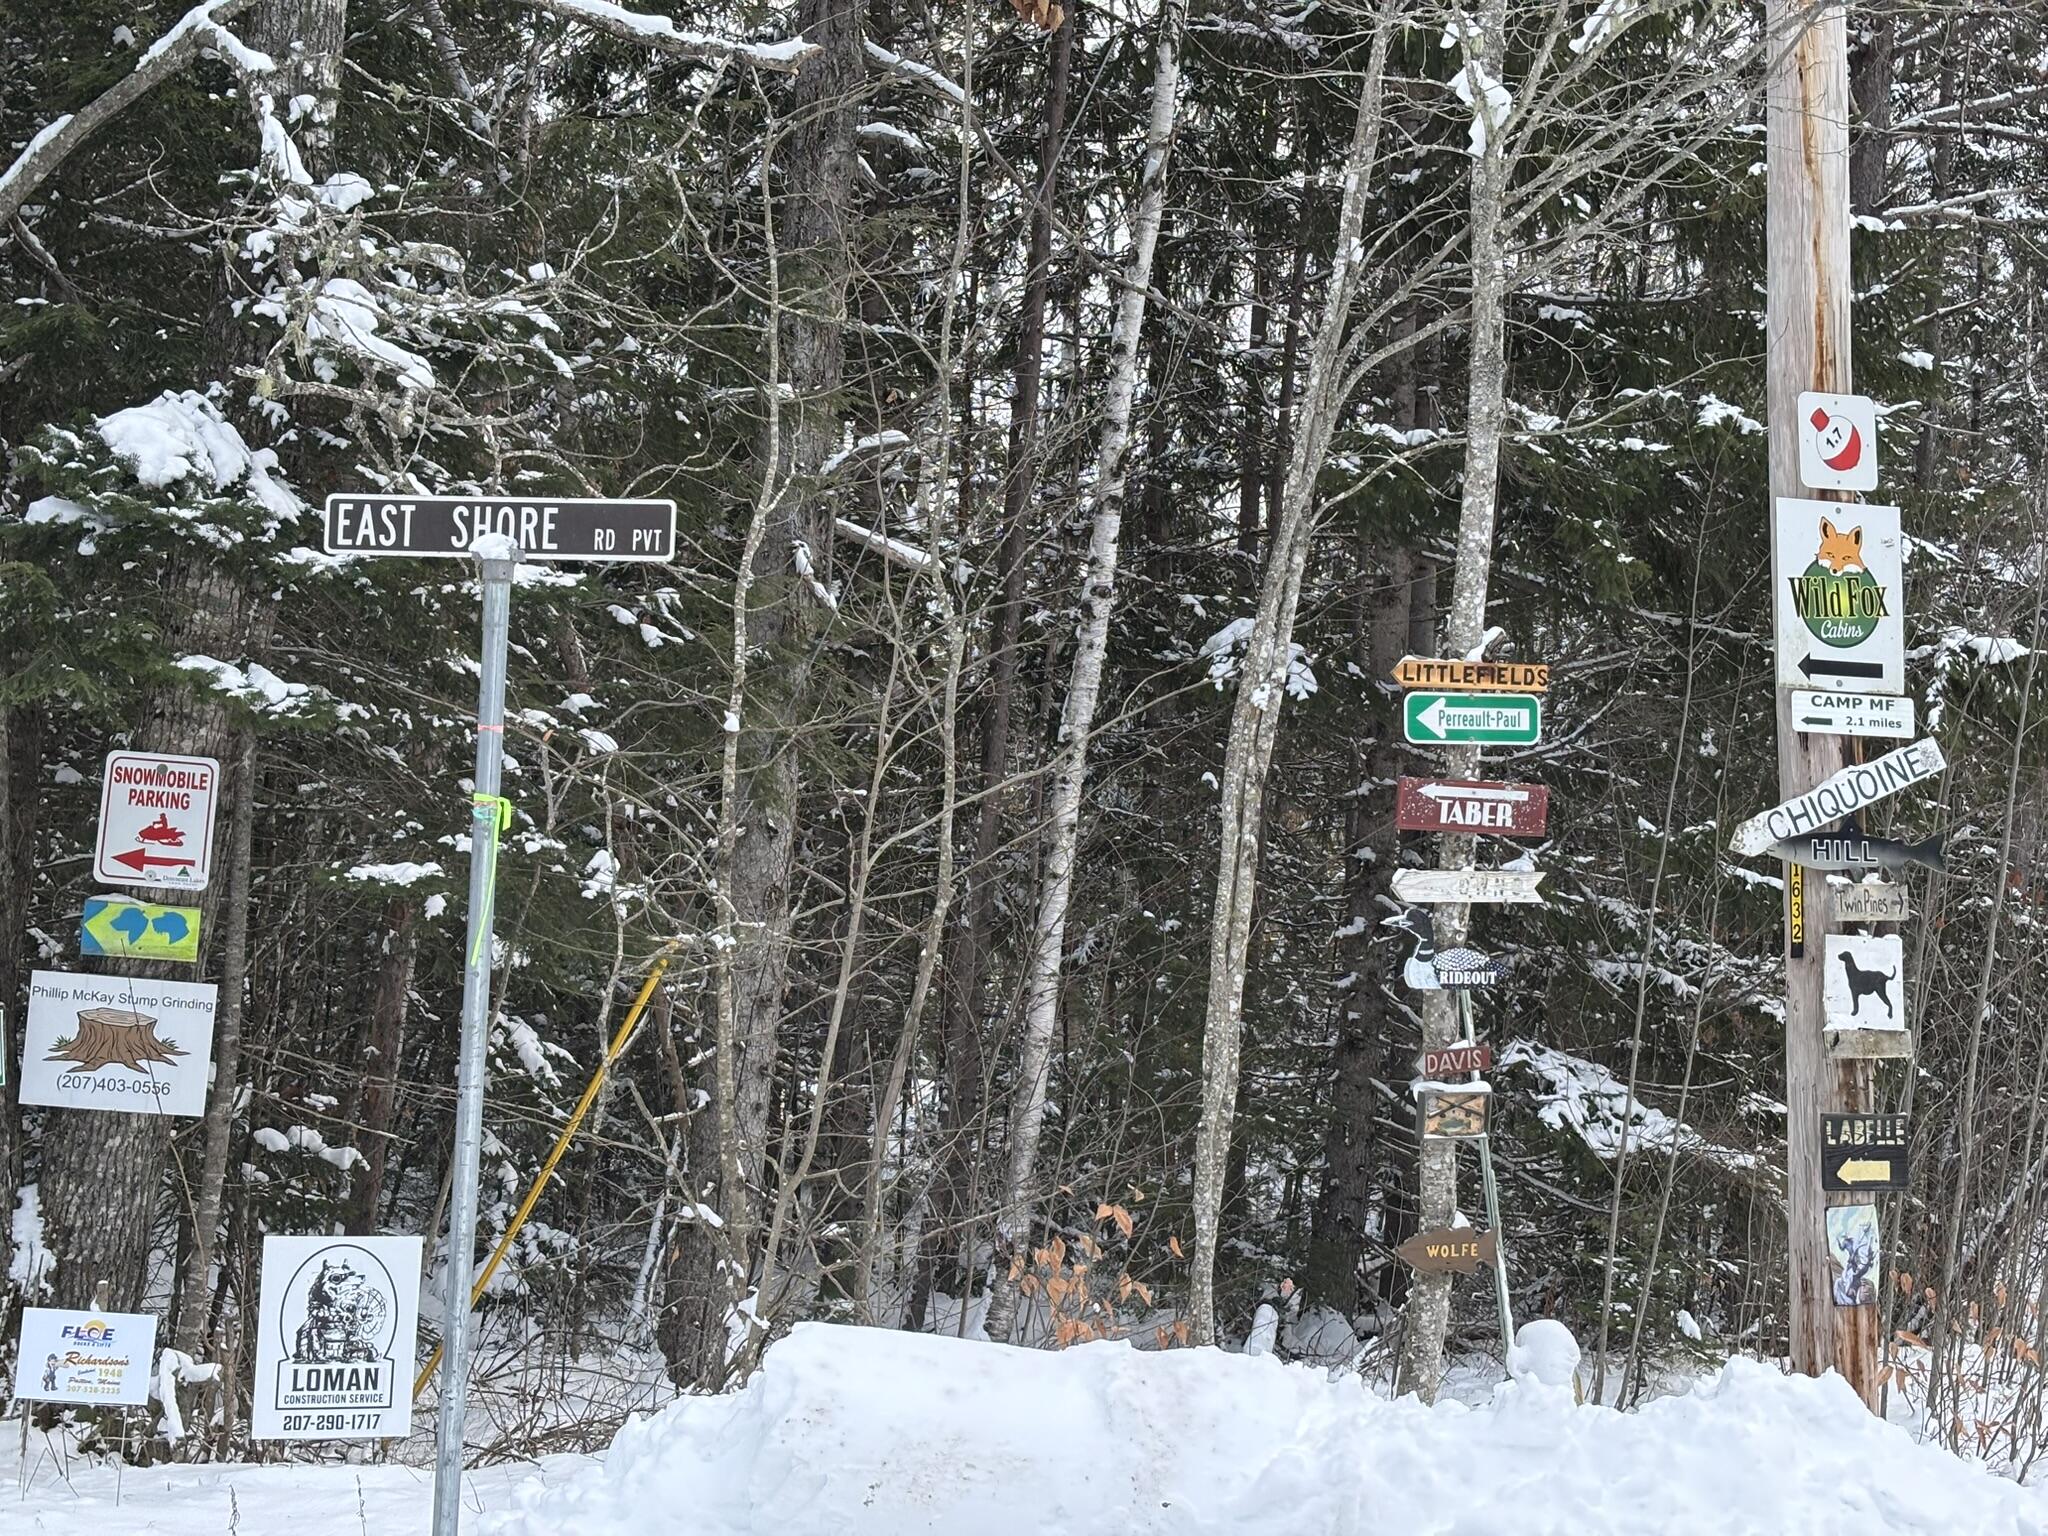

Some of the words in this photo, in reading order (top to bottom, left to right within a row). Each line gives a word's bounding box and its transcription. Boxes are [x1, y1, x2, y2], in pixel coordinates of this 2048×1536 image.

[1825, 426, 1843, 449] 1.7
[336, 503, 417, 547] EAST
[450, 505, 559, 550] SHORE
[593, 528, 617, 552] RD
[631, 529, 663, 552] PVT
[1787, 576, 1843, 619] Wild
[1844, 576, 1891, 618] Fox
[1820, 619, 1865, 639] Cabins
[1402, 662, 1548, 687] LITTLEFIELD'S
[1810, 694, 1863, 709] CAMP
[1869, 699, 1896, 712] MF
[1438, 709, 1521, 729] Perreault-Paul
[1845, 716, 1865, 727] 2.1
[1869, 717, 1902, 729] miles
[113, 765, 209, 791] SNOWMOBILE
[127, 788, 191, 811] PARKING
[1766, 746, 1931, 841] CHIQUOINE
[1435, 798, 1514, 828] TABER
[1811, 838, 1879, 864] HILL
[1791, 863, 1802, 941] 1632
[1835, 888, 1862, 914] Twin
[1863, 888, 1888, 915] Pines
[1439, 970, 1498, 985] RIDEOUT
[31, 985, 70, 1001] Phillip
[72, 988, 115, 1006] McKay
[118, 992, 158, 1008] Stump
[161, 996, 214, 1014] Grinding
[1426, 1049, 1482, 1074] DAVIS
[56, 1074, 171, 1096] (207)403-0556
[1825, 1118, 1906, 1146] LABELLE
[1425, 1242, 1479, 1258] WOLFE
[63, 1350, 130, 1366] Richardson's
[98, 1367, 123, 1378] 1948
[291, 1367, 380, 1392] LOMAN
[283, 1394, 347, 1405] CONSTRUCTION
[349, 1393, 384, 1404] SERVICE
[282, 1413, 381, 1431] 207-290-1717
